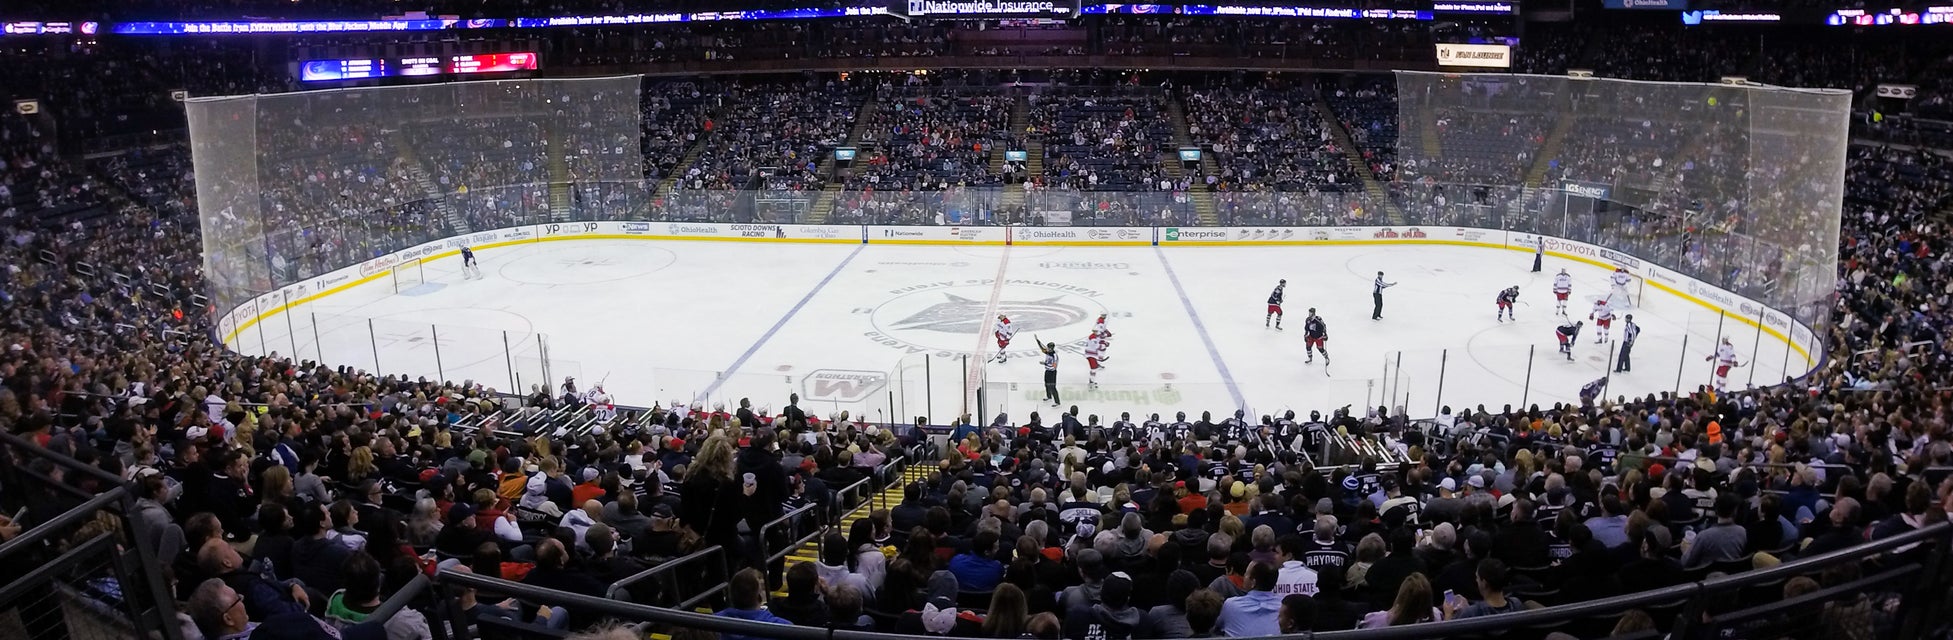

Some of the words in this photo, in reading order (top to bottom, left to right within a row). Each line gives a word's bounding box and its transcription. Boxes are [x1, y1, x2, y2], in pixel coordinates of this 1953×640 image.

[844, 7, 859, 15] Join
[860, 7, 870, 15] the
[925, 0, 993, 11] Nationwide
[997, 0, 1054, 11] Insurance
[1217, 6, 1246, 15] Available
[1247, 7, 1261, 15] now
[1262, 7, 1272, 15] for
[1313, 8, 1324, 16] and
[549, 17, 577, 26] Available
[578, 17, 592, 25] now
[593, 16, 603, 24] for
[643, 14, 654, 23] and
[184, 23, 198, 33] Join
[200, 23, 211, 33] the
[212, 23, 232, 33] Battle
[233, 23, 249, 33] from
[250, 22, 298, 32] EVERYWHERE
[299, 23, 315, 32] with
[316, 22, 327, 31] the
[328, 22, 343, 31] Blue
[344, 22, 368, 31] Jackets
[369, 21, 392, 30] Mobile
[393, 21, 408, 30] App!
[1456, 51, 1472, 59] FAN
[1472, 52, 1504, 60] LOUNGE
[1565, 183, 1579, 193] IGS
[1580, 186, 1605, 197] ENERGY
[545, 223, 560, 235] yp
[583, 222, 598, 233] yp
[680, 226, 718, 234] OhioHealth
[730, 224, 751, 232] SCIOTO
[1033, 230, 1077, 238] OhioHealth
[1169, 229, 1226, 239] enterprise
[1560, 242, 1597, 257] TOYOTA
[888, 279, 955, 296] Arena
[1698, 287, 1734, 307] OhioHealth
[863, 330, 926, 356] Arena
[596, 409, 607, 421] 22
[1273, 583, 1291, 594] OHIO
[1293, 583, 1315, 594] STATE
